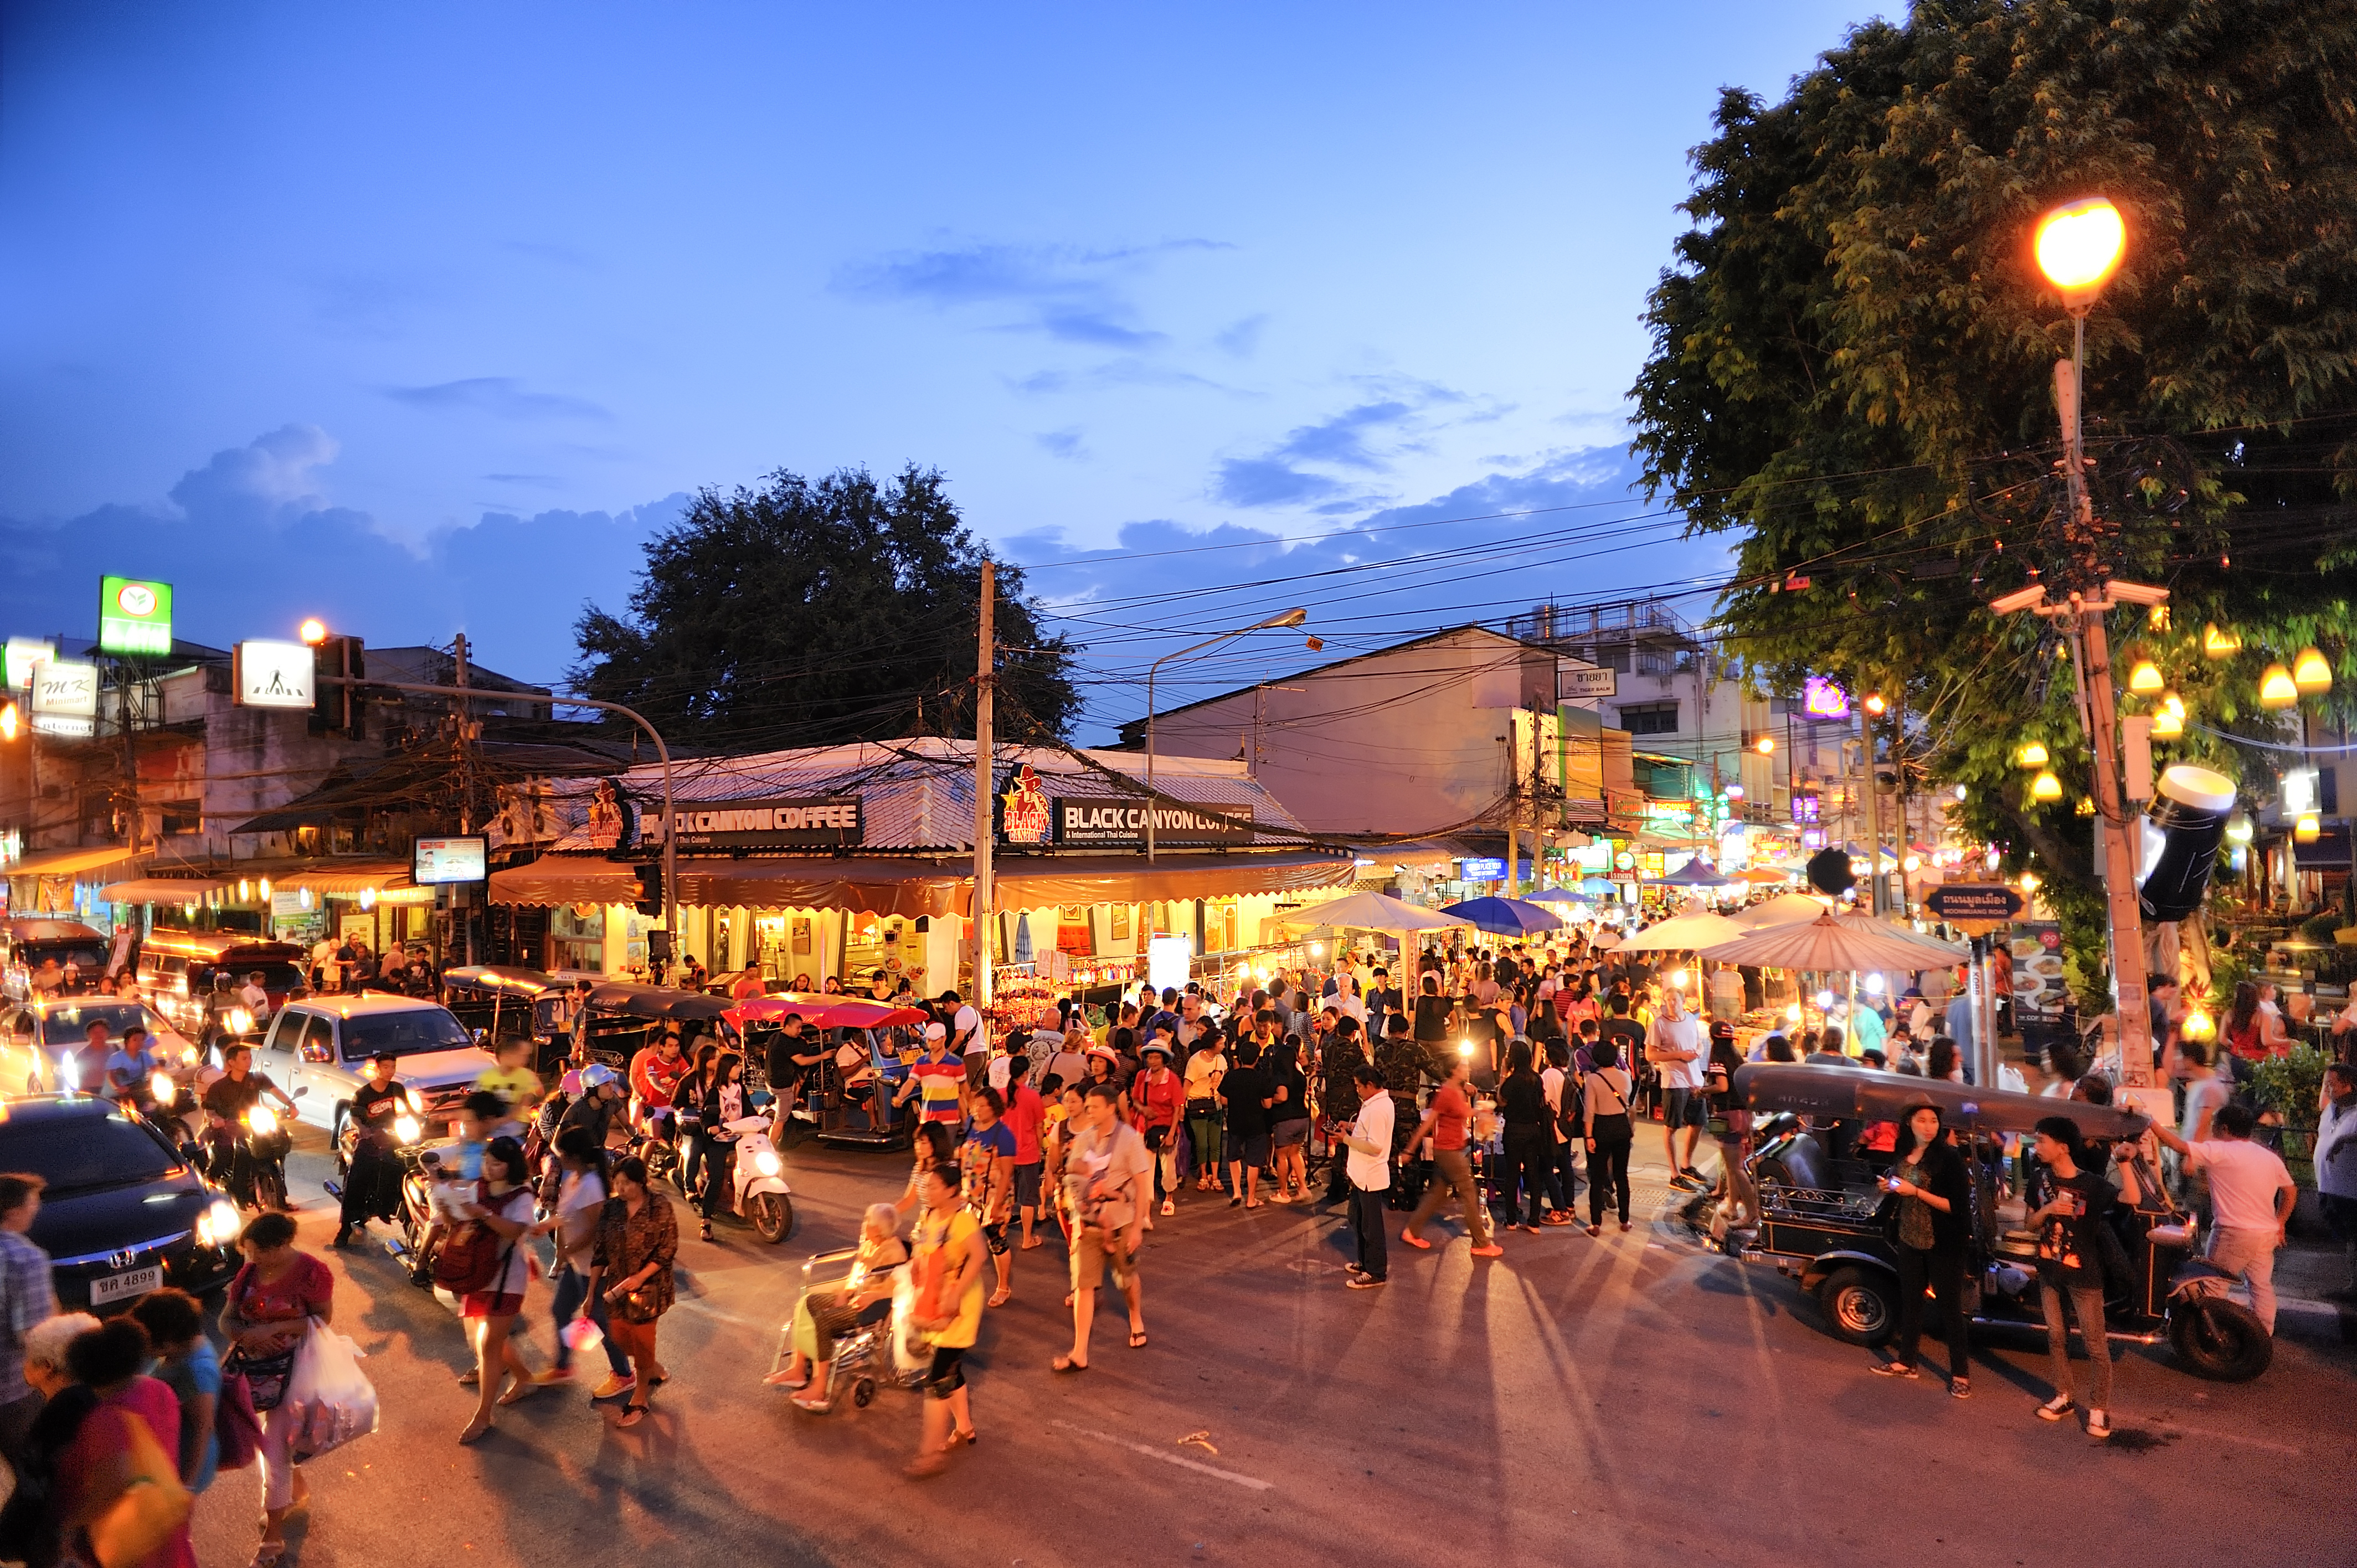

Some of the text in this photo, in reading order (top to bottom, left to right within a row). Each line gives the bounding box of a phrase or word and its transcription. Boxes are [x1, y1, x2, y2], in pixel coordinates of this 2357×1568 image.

[45, 695, 87, 706] Minimart
[40, 722, 93, 732] nternet
[696, 808, 773, 832] CANYON
[774, 805, 856, 829] COFFEE
[1005, 811, 1046, 832] BLACK
[1066, 807, 1125, 828] BLACK
[1126, 809, 1193, 829] CANYON
[589, 821, 621, 839] BLACK
[1009, 830, 1041, 843] CANYON
[1943, 893, 2007, 907] ถนนมูลเมือง
[123, 1270, 155, 1286] 4899
